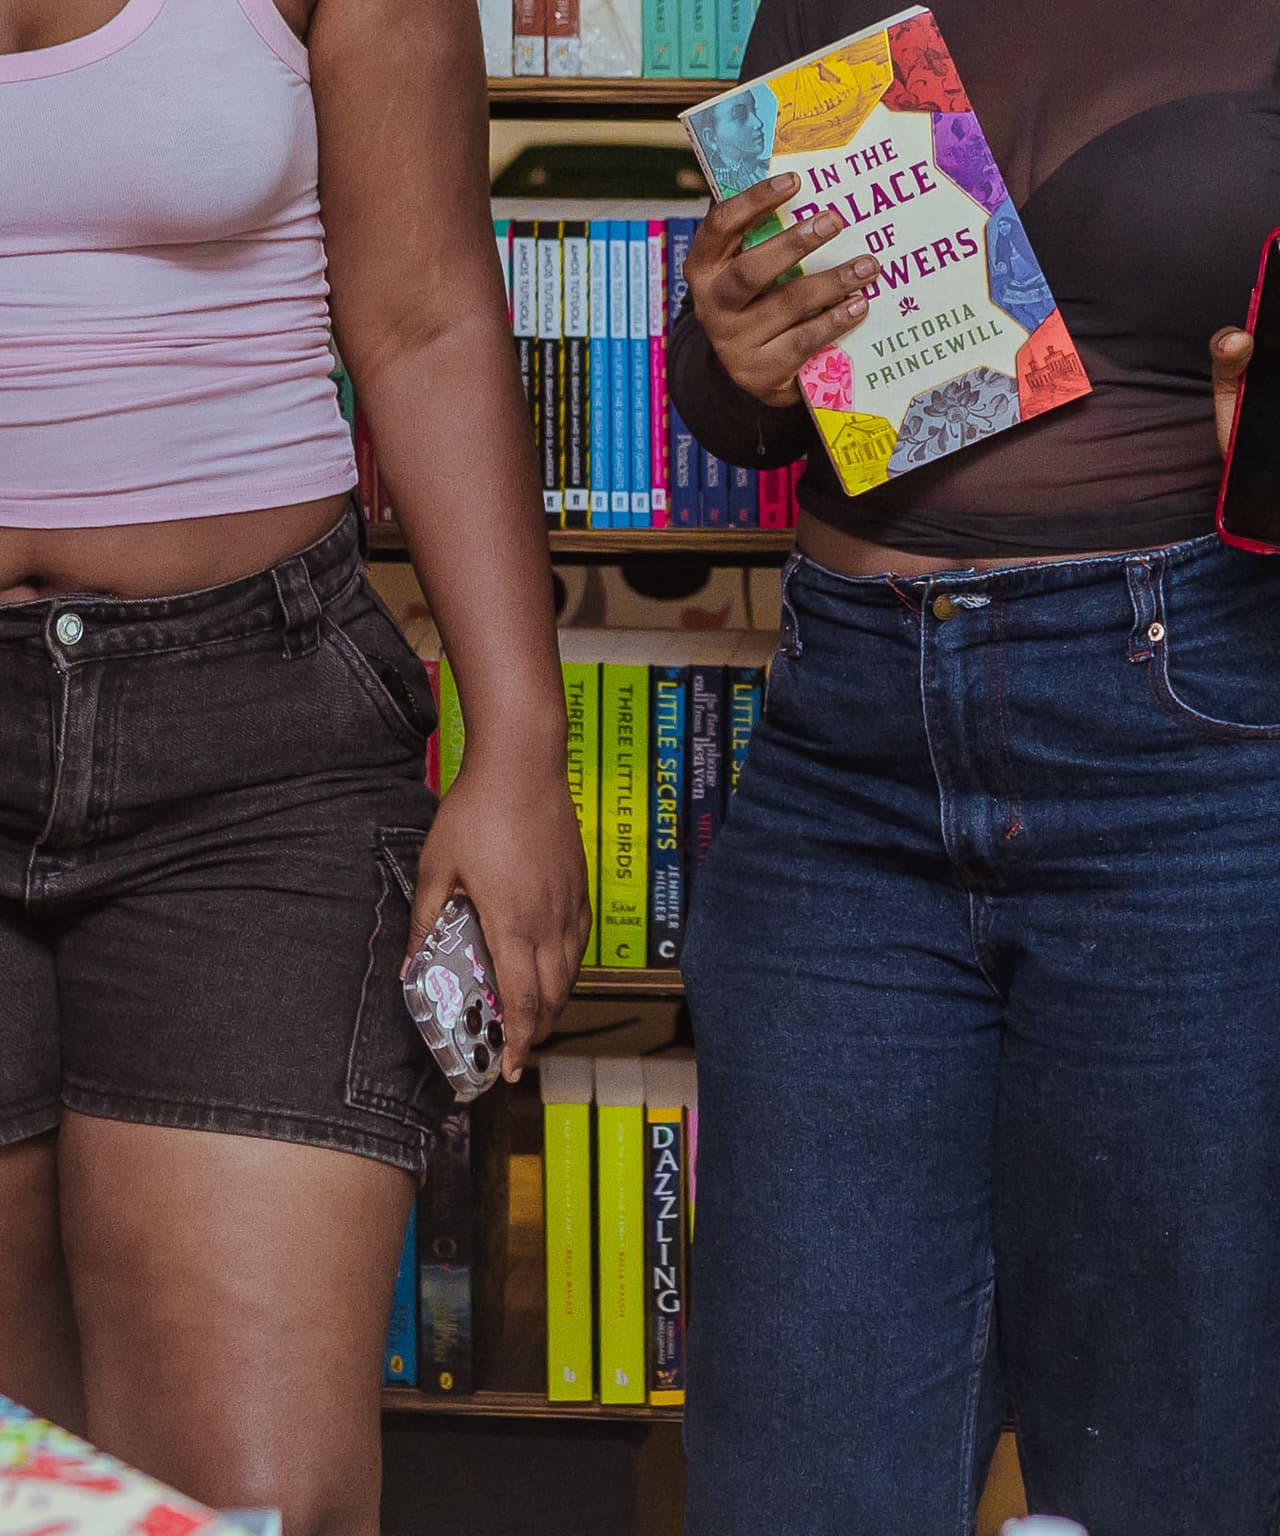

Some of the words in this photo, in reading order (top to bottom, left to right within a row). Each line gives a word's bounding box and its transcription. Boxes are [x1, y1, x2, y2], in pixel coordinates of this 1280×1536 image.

[807, 163, 841, 194] IN
[845, 138, 898, 176] THE
[865, 223, 896, 254] OF
[865, 320, 1004, 391] PRINCEWILL
[872, 303, 976, 358] VICTORIA
[569, 680, 585, 743] THREE
[618, 684, 634, 747] THREE
[657, 681, 678, 749] LITTLE
[732, 683, 753, 750] LITTLE
[618, 753, 634, 817] LITTLE
[657, 758, 678, 850] SECRETS
[618, 823, 634, 880] BIRDS
[655, 869, 667, 921] HILLIER
[667, 864, 680, 929] JENNIFER
[653, 1126, 680, 1313] DAZZLING
